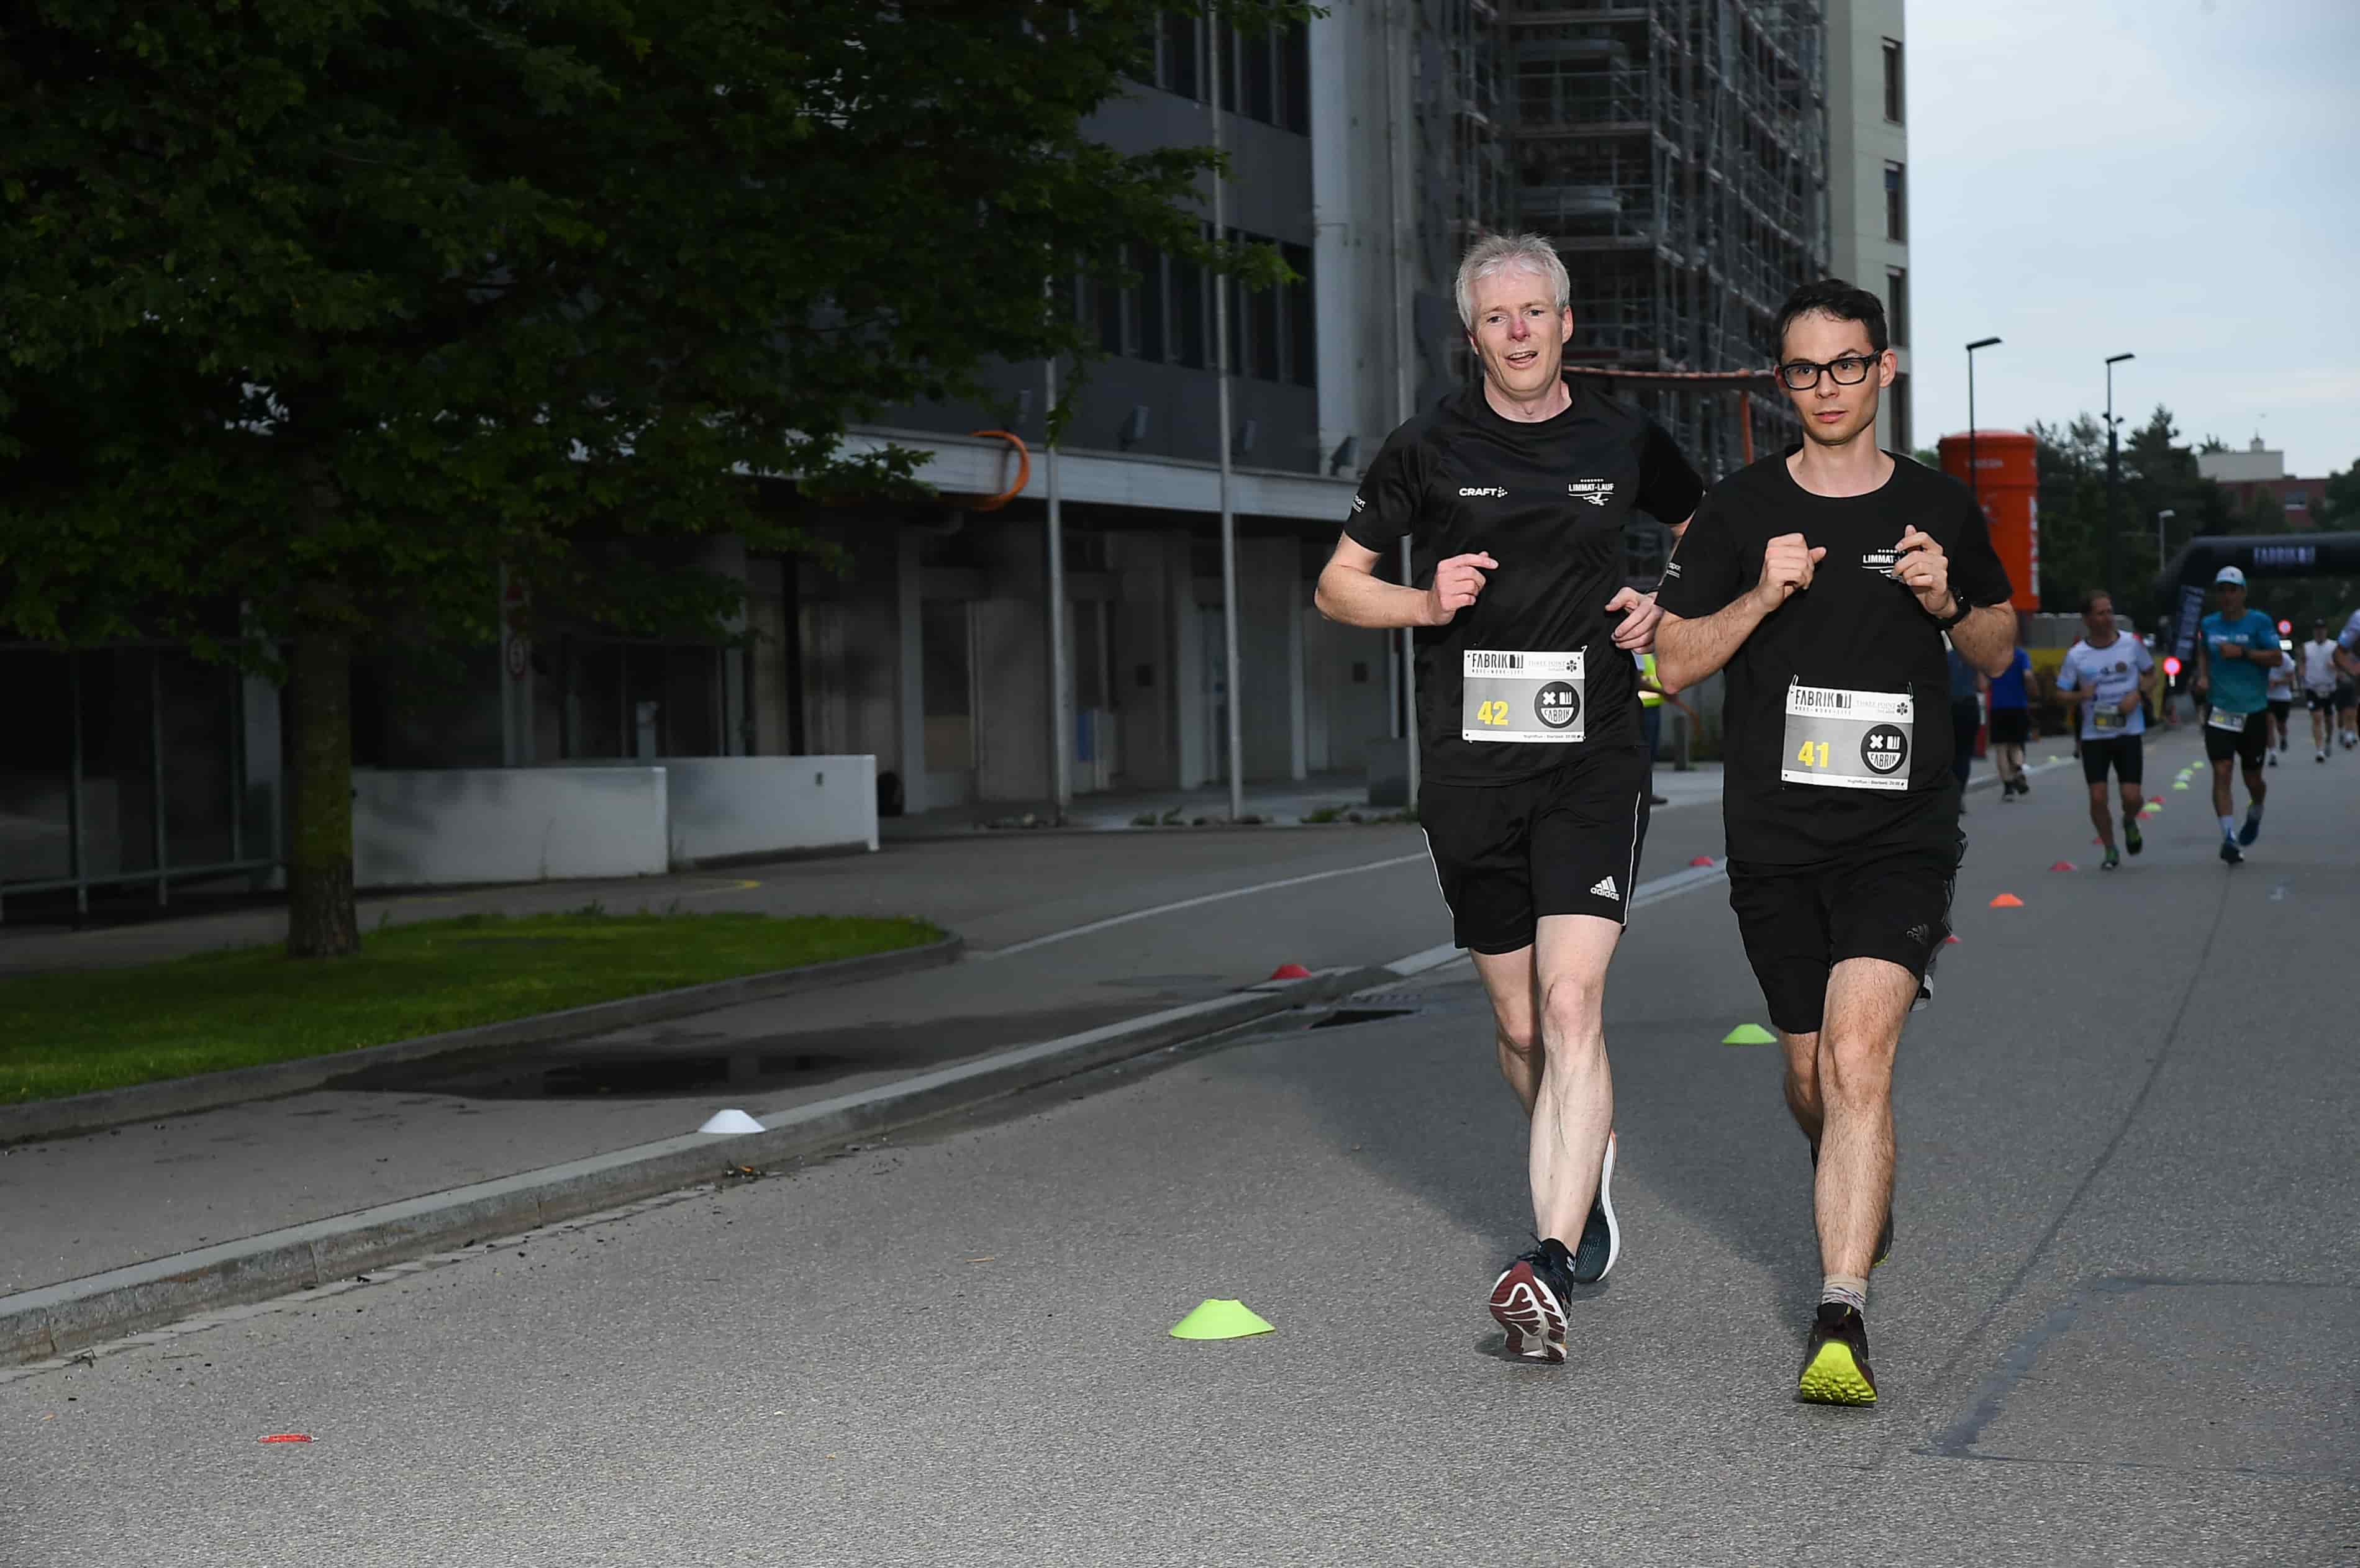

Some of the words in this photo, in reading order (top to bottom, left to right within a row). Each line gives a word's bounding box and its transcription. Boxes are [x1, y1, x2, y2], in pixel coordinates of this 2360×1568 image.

[1459, 487, 1497, 497] CRAFT
[1568, 483, 1615, 492] LIMMAT-LAUF
[1472, 653, 1508, 668] FABRIK
[1795, 689, 1834, 707] FABRIK
[1477, 700, 1509, 725] 42
[1545, 709, 1570, 722] FABRIK
[1798, 741, 1829, 768] 41
[1870, 753, 1897, 768] FABRIK
[1590, 887, 1620, 901] adidas
